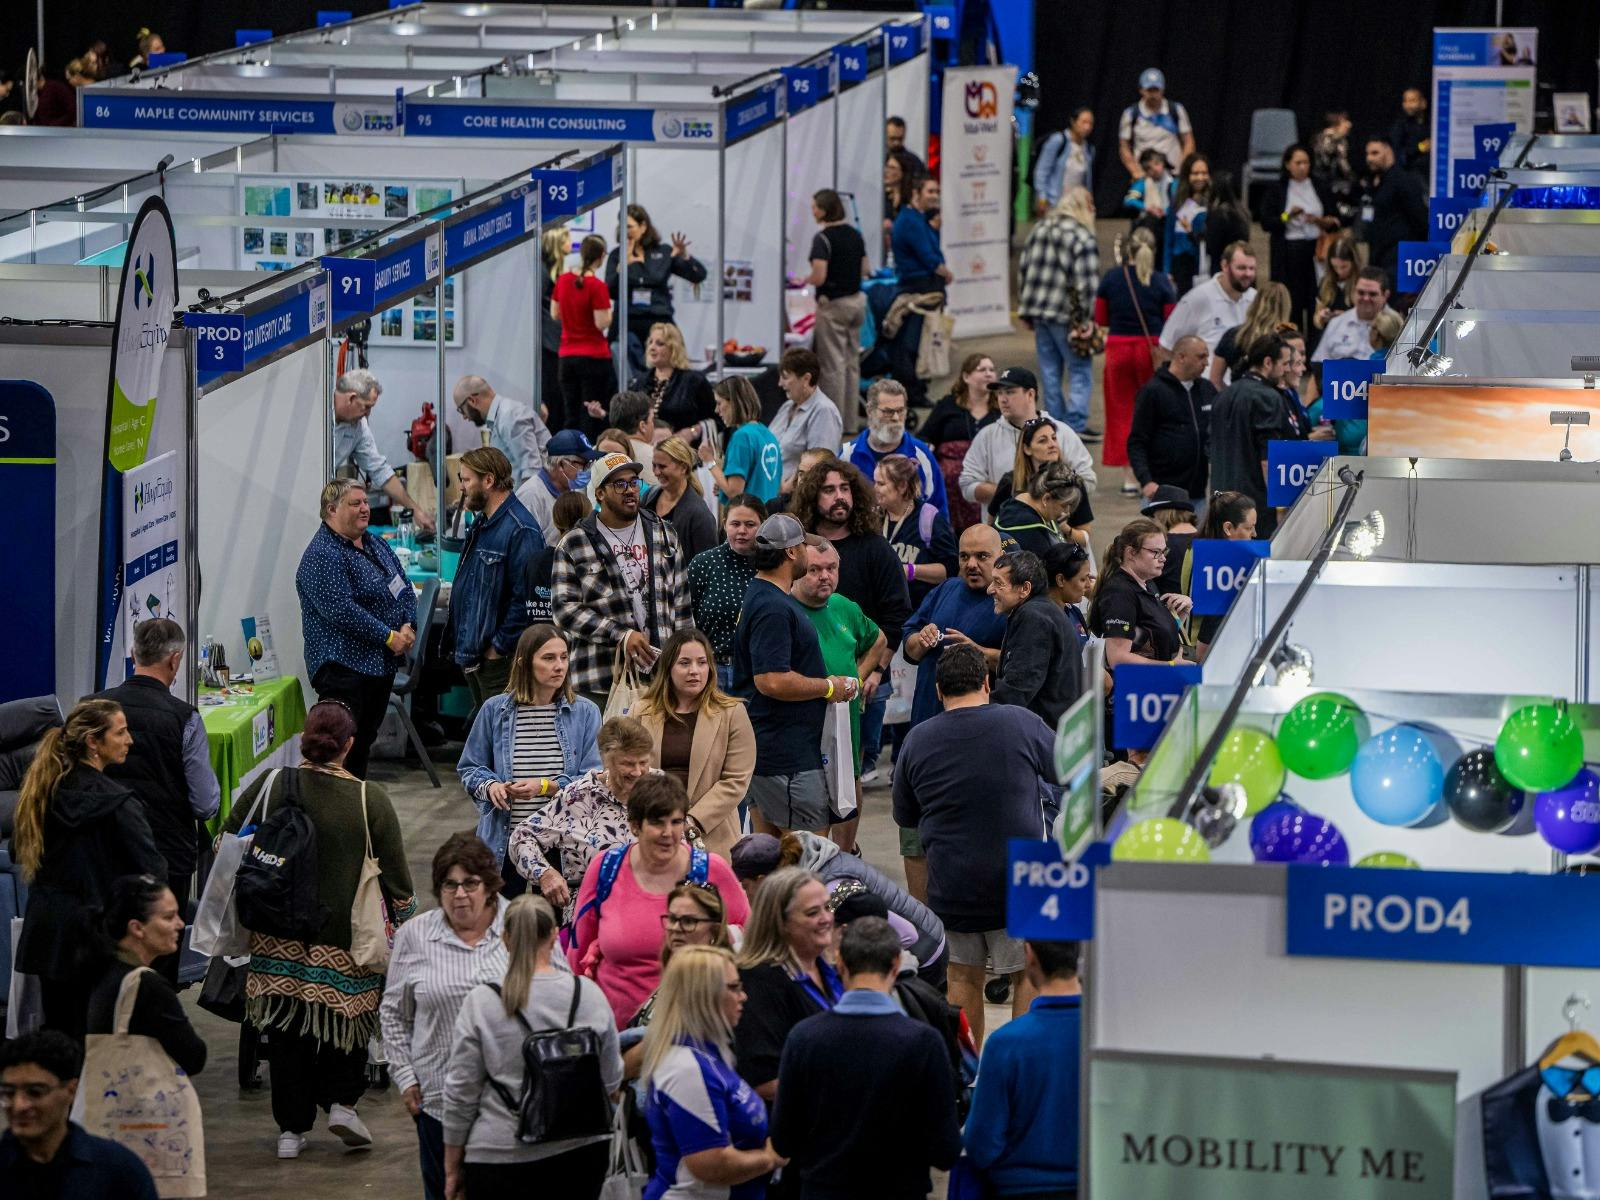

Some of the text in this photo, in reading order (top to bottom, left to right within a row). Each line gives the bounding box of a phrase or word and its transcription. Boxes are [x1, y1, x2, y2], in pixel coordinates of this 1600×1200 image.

[892, 36, 908, 50] 97
[843, 57, 860, 71] 96
[792, 79, 810, 93] 95
[95, 106, 110, 118] 86
[134, 107, 315, 123] MAPLE COMMUNITY SERVICES
[417, 114, 432, 126] 95
[364, 121, 394, 131] EXPO
[463, 115, 627, 131] CORE HEALTH CONSULTING
[683, 128, 713, 138] EXPO
[1482, 137, 1501, 152] 99
[1459, 173, 1487, 189] 100
[548, 185, 569, 201] 93
[1436, 213, 1464, 230] 101
[391, 258, 411, 284] SERVICES
[1404, 258, 1437, 277] 102
[341, 276, 361, 295] 91
[198, 326, 241, 341] PROD
[254, 318, 278, 347] INTEGRITY
[278, 312, 292, 336] CARE
[214, 345, 224, 360] 3
[1330, 380, 1368, 401] 104
[1276, 464, 1319, 487] 105
[1202, 565, 1248, 591] 106
[531, 608, 546, 616] the
[1126, 693, 1181, 723] 107
[1013, 860, 1090, 889] PROD
[1040, 894, 1060, 921] 4
[1324, 893, 1472, 935] PROD4
[1121, 1132, 1427, 1183] MOBILITY ME
